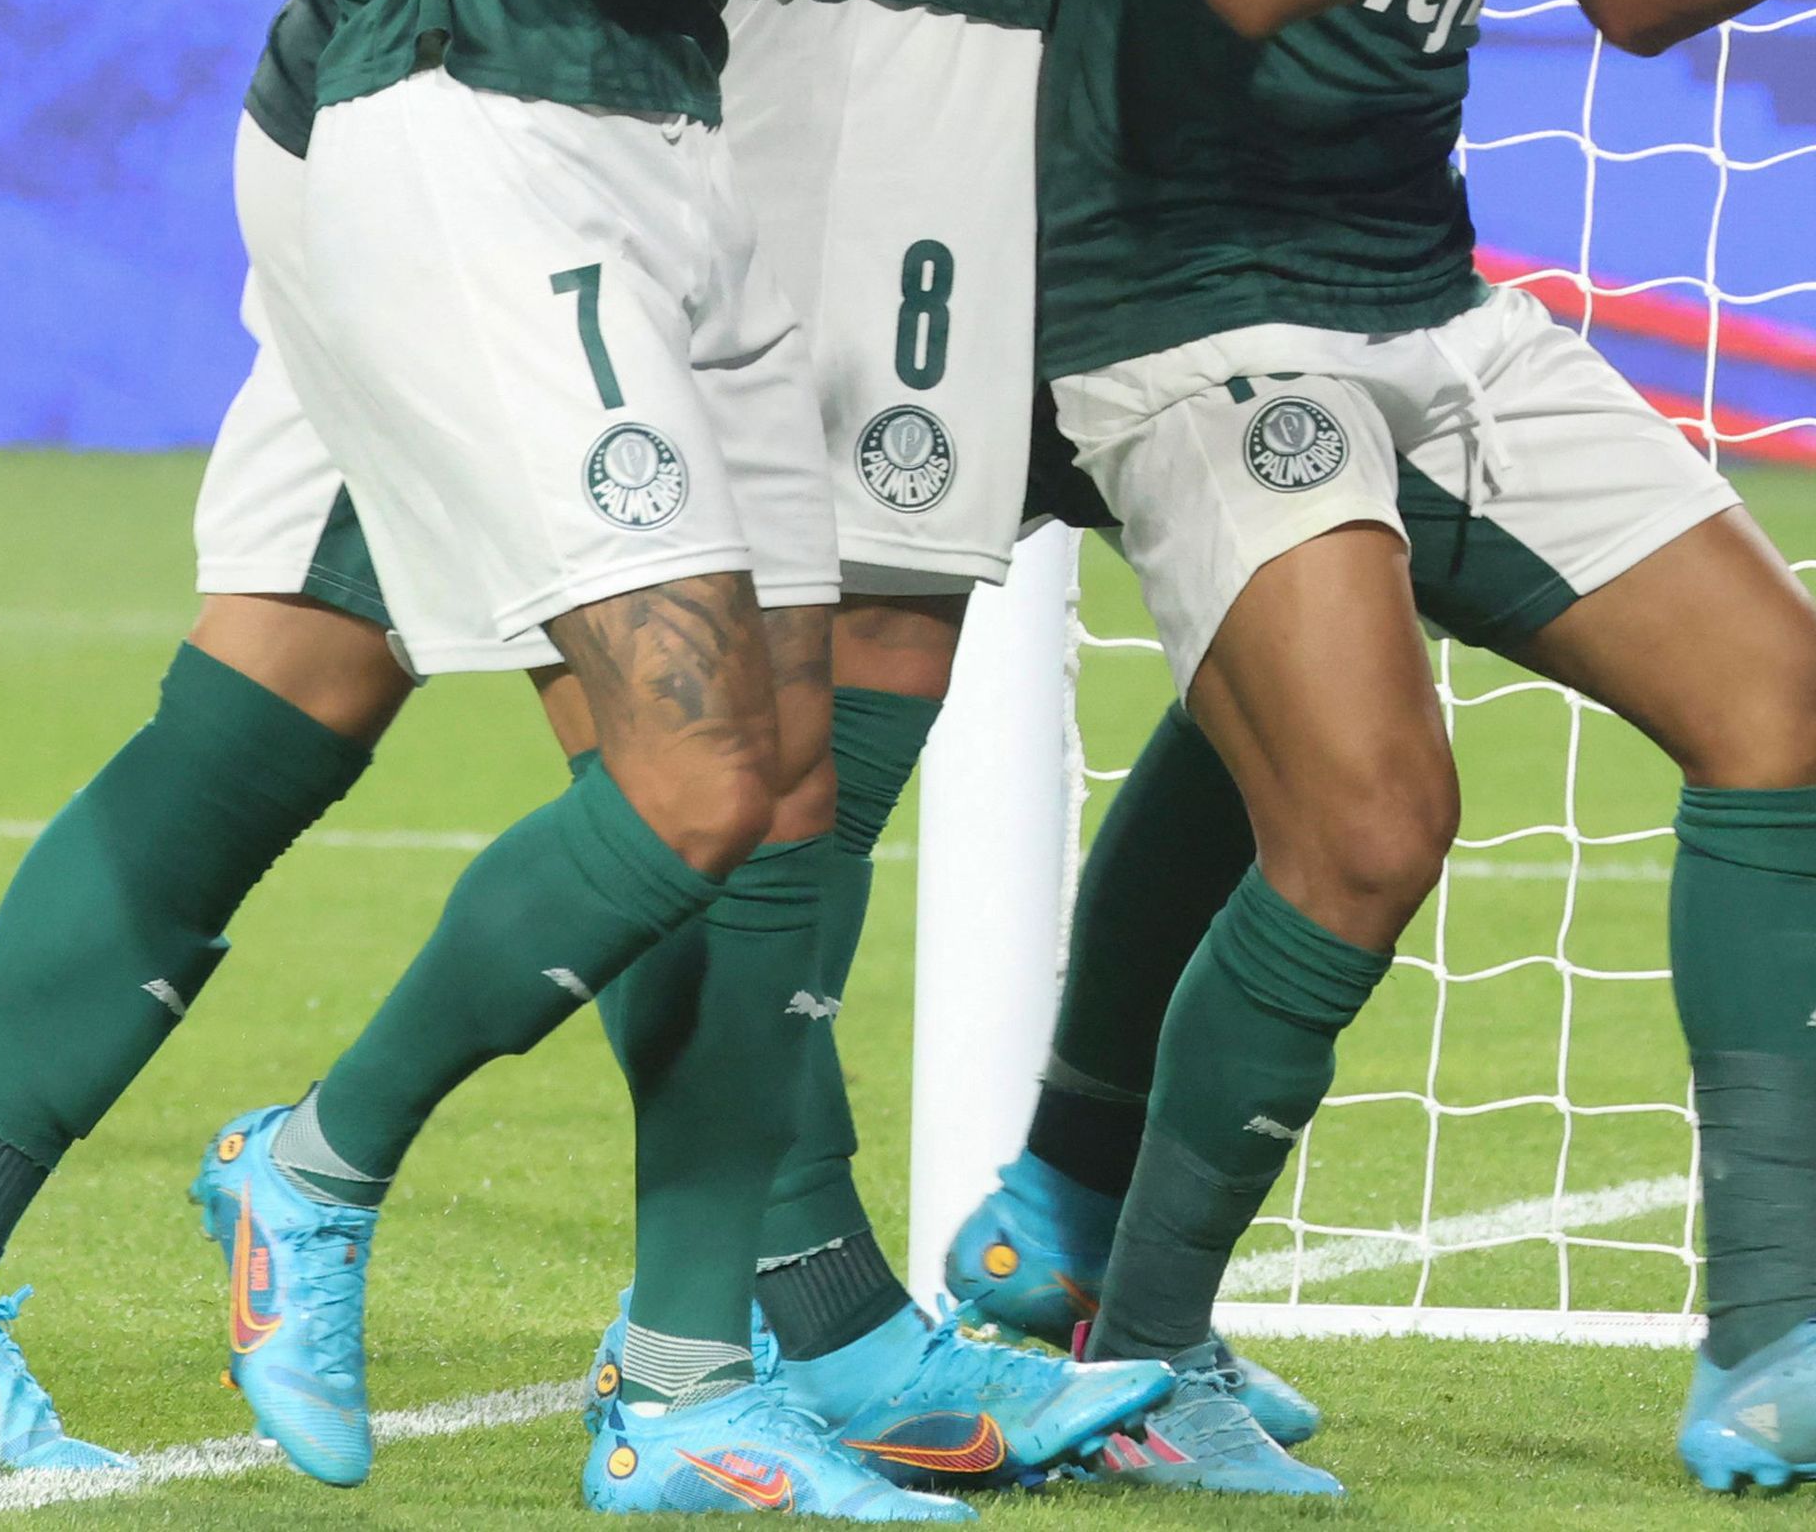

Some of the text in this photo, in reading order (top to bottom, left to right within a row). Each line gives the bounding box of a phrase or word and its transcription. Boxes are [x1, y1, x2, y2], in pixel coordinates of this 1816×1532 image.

[549, 262, 625, 410] 7
[894, 238, 955, 391] 8
[862, 450, 949, 506] PALMEIRAS
[1252, 429, 1344, 486] PALMEIRAS
